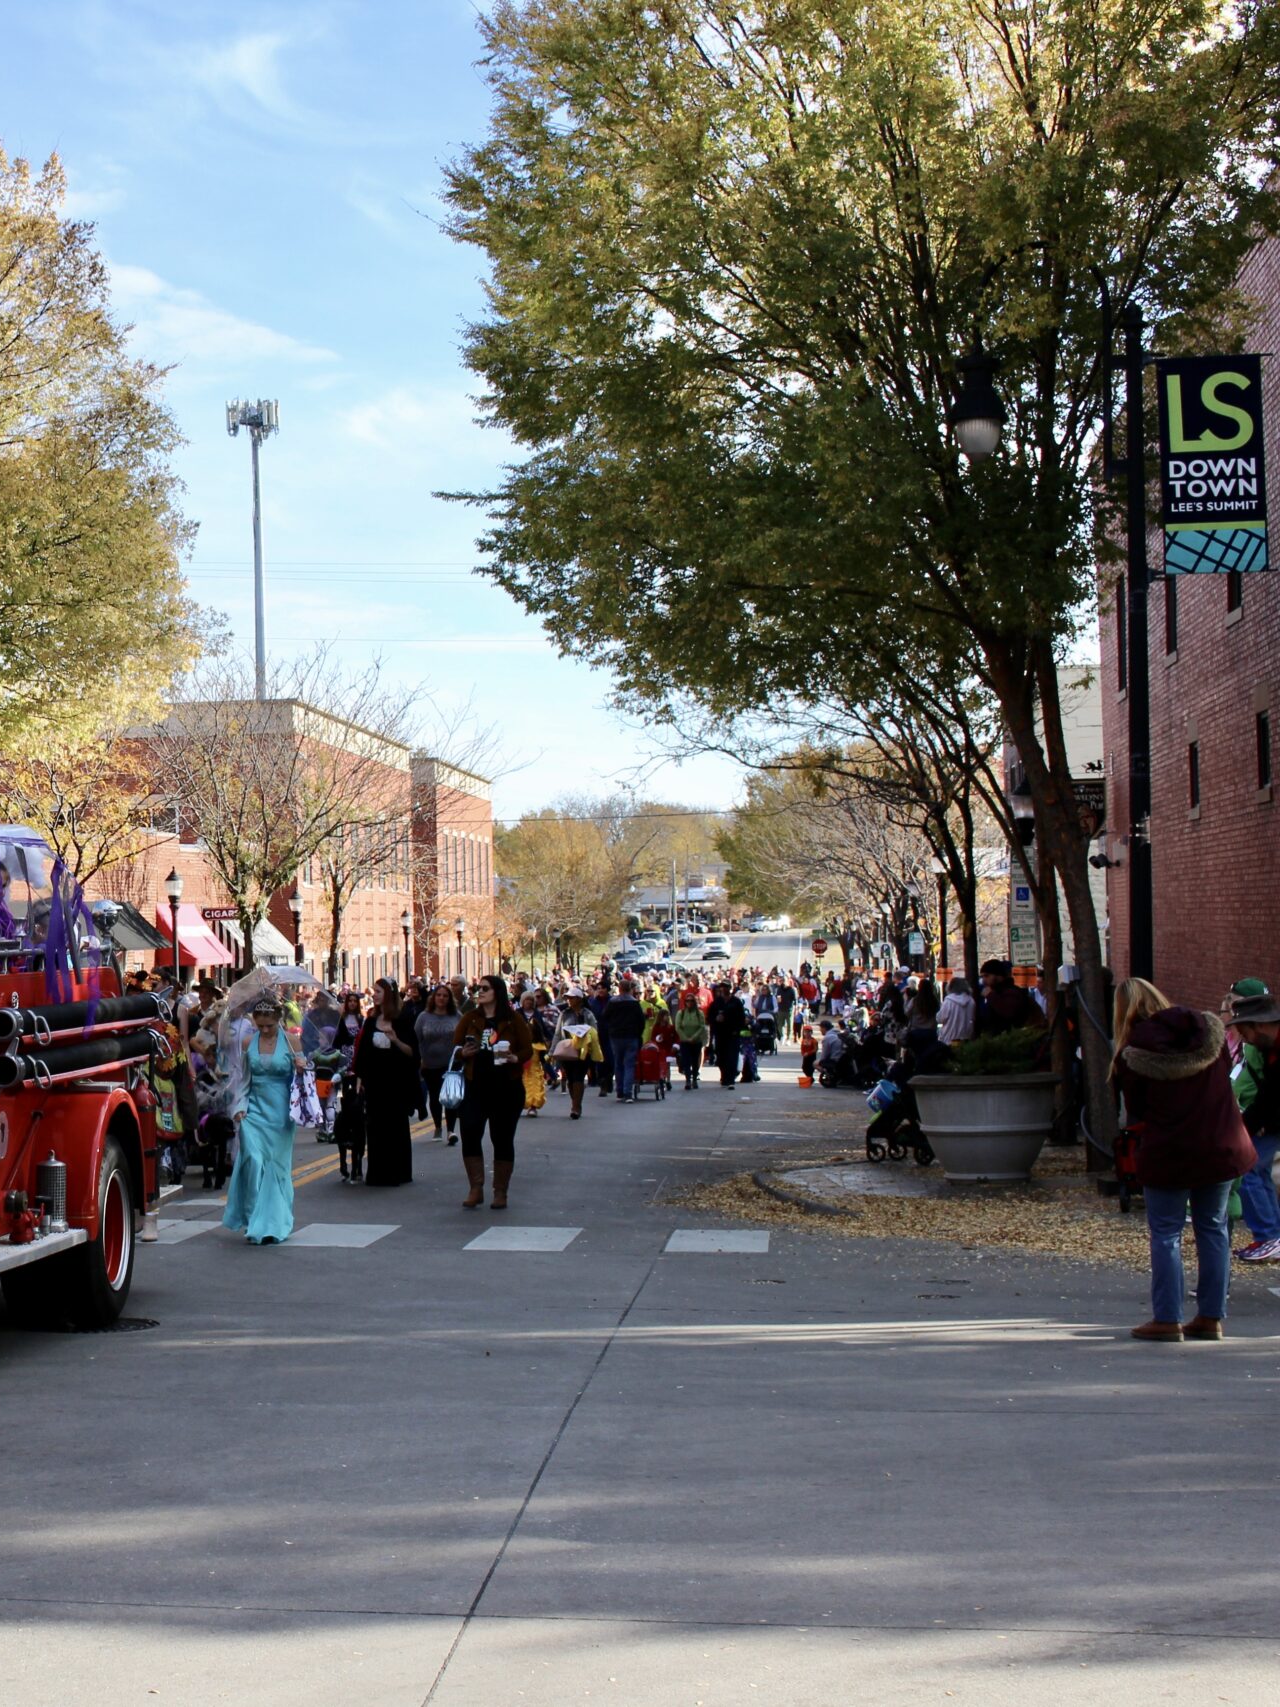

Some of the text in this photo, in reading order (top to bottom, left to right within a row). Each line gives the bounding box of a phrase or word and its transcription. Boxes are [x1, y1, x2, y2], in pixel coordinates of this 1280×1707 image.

[1166, 371, 1254, 453] LS
[1169, 458, 1256, 478] DOWN
[1169, 478, 1257, 498] TOWN
[1171, 500, 1258, 512] LEE'S SUMMIT
[1011, 929, 1018, 940] 2
